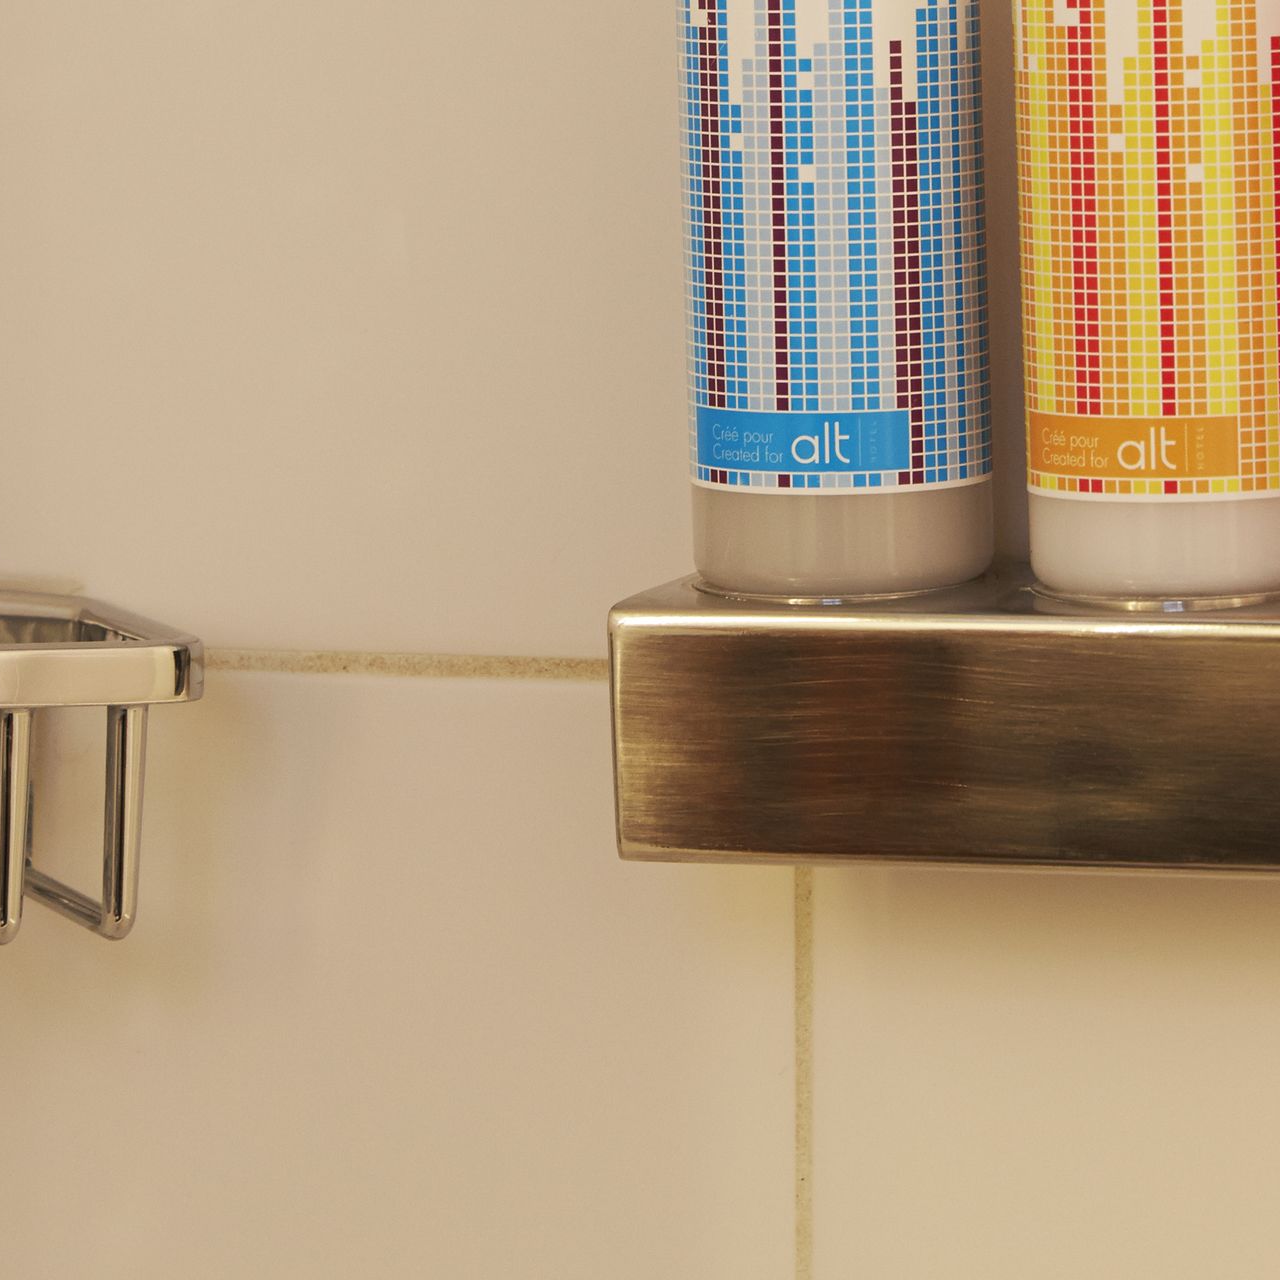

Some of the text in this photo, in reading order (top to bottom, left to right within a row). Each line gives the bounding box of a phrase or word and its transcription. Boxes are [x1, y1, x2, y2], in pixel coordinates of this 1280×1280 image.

[712, 424, 773, 445] Créé pour
[791, 421, 850, 464] alt
[1042, 427, 1098, 449] Créé pour
[712, 443, 783, 463] Created for
[1042, 447, 1109, 468] Created for
[1117, 426, 1177, 470] alt
